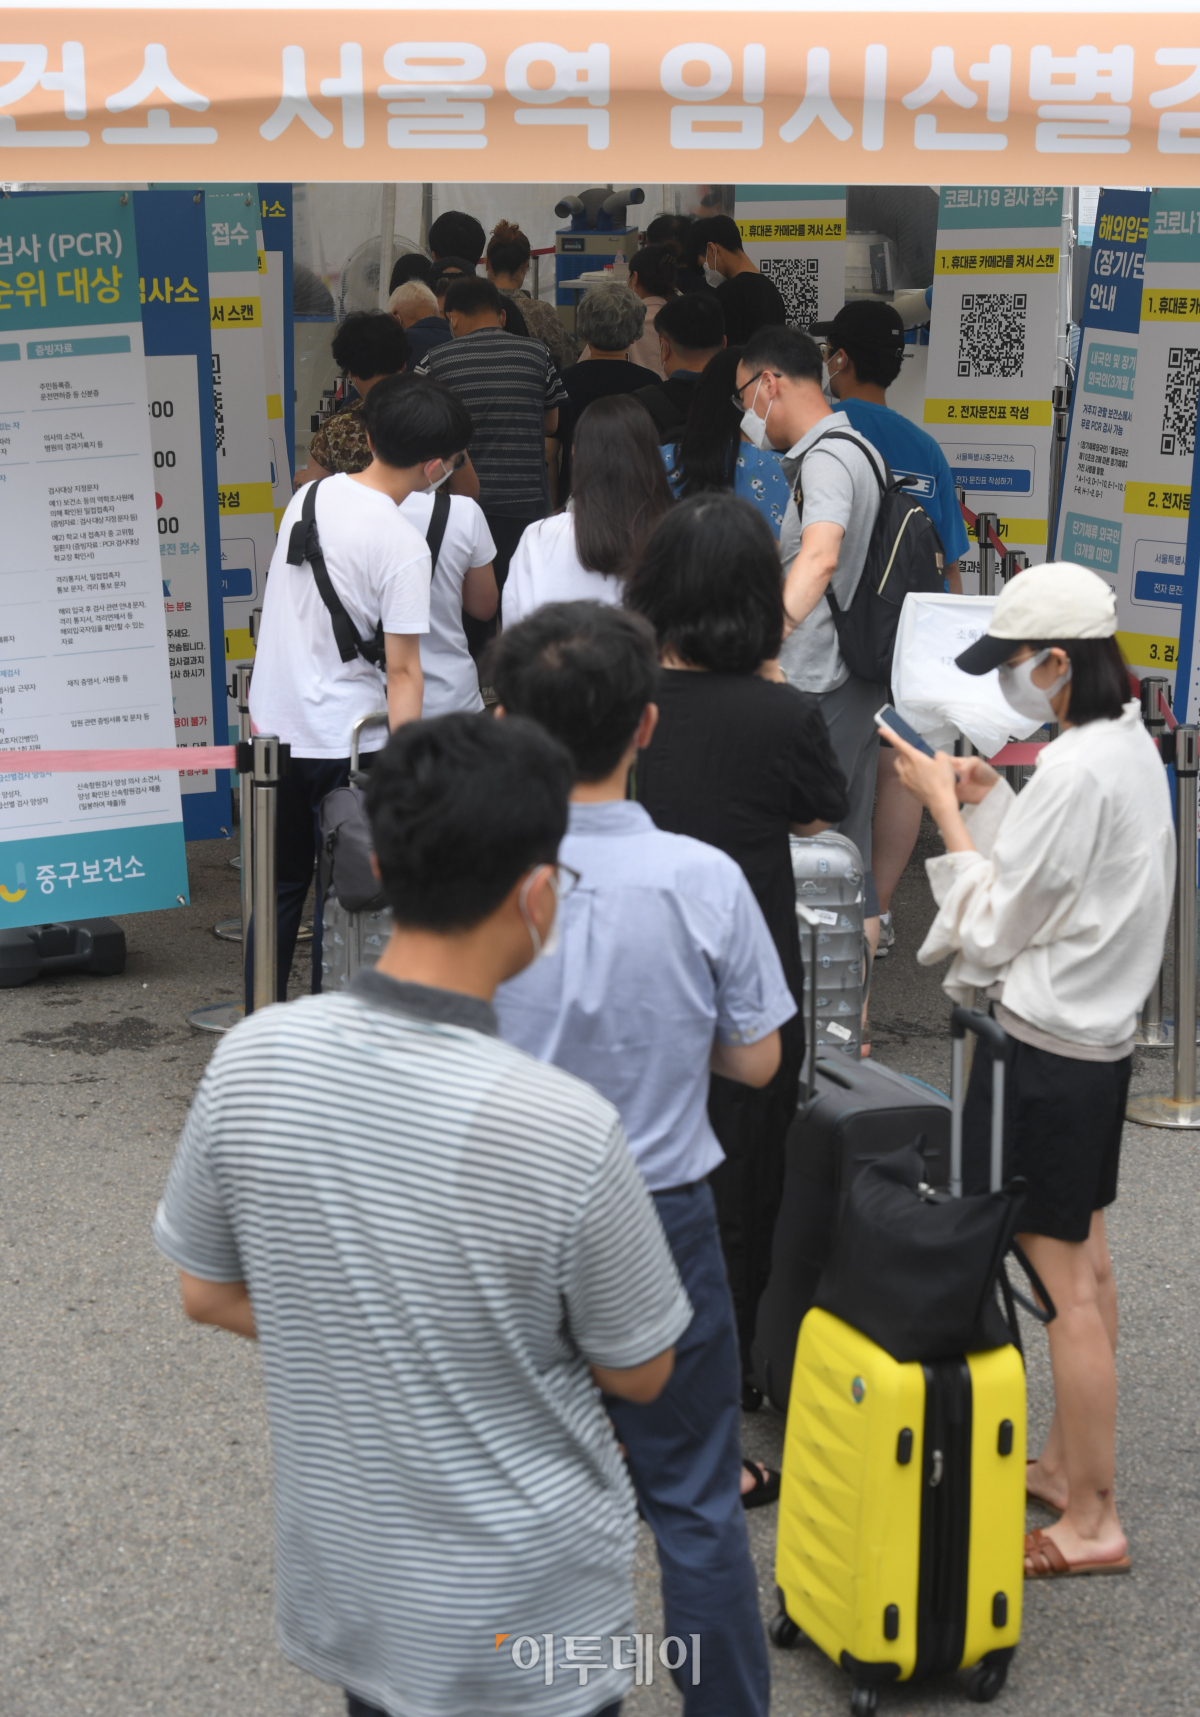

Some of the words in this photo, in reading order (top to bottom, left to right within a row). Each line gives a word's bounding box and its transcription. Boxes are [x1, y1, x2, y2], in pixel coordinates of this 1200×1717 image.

[0, 40, 218, 147] 건소
[259, 40, 611, 151] 서울역
[944, 189, 1001, 208] 코로나19
[1004, 188, 1029, 207] 검사
[1033, 187, 1059, 206] 접수
[211, 222, 249, 246] 접수
[740, 227, 747, 237] 1.
[749, 225, 772, 237] 휴대폰
[774, 224, 805, 237] 카메라를
[807, 224, 823, 236] 켜서
[825, 224, 841, 236] 스캔
[48, 229, 122, 263] (PCR)
[941, 257, 949, 269] 1.
[951, 255, 977, 269] 휴대폰
[979, 254, 1014, 269] 카메라를
[1016, 254, 1034, 268] 켜서
[1036, 254, 1054, 268] 스캔
[57, 265, 123, 304] 대상
[1089, 283, 1117, 312] 안내
[227, 304, 254, 321] 스캔
[1148, 297, 1157, 313] 1.
[1158, 296, 1188, 315] 휴대폰
[35, 343, 73, 357] 증빙자료
[1090, 350, 1112, 368] 내국인
[1113, 354, 1121, 369] 및
[40, 381, 73, 392] 주민등록증,
[40, 390, 71, 402] 운전면허증
[73, 389, 79, 399] 등
[81, 387, 99, 399] 신분증
[947, 405, 957, 419] 2.
[960, 405, 1007, 420] 전자문진표
[1009, 406, 1029, 420] 작성
[1083, 404, 1097, 416] 거주지
[1098, 406, 1108, 419] 관할
[1108, 408, 1133, 423] 보건소에서
[1080, 418, 1090, 431] 무료
[1091, 421, 1101, 432] PCR
[1102, 422, 1112, 435] 검사
[1113, 424, 1124, 436] 가능
[44, 434, 63, 443] 의사의
[64, 432, 85, 443] 소견서,
[45, 443, 63, 453] 병원의
[65, 440, 96, 452] 경과기록지
[98, 440, 103, 450] 등
[153, 451, 176, 469] 00
[955, 452, 1015, 463] 서울특별시중구보건소
[955, 476, 968, 484] 전자
[969, 476, 987, 485] 문진표
[988, 476, 1013, 486] 작성하기
[48, 486, 73, 496] 검사대상
[74, 483, 99, 494] 지정문자
[64, 497, 82, 506] 보건소
[84, 496, 96, 505] 등의
[1148, 491, 1158, 508] 2.
[51, 508, 63, 517] 의해
[65, 506, 83, 517] 확인된
[84, 505, 115, 516] 밀접접촉자
[51, 517, 76, 528] (증빙자료
[157, 516, 180, 534] 00
[66, 532, 78, 541] 학교
[80, 531, 87, 540] 내
[88, 530, 106, 540] 접촉자
[108, 529, 114, 538] 중
[115, 528, 134, 538] 고위험
[1072, 520, 1098, 540] 단기체류
[1099, 525, 1120, 546] 외국인
[53, 543, 71, 553] 질환자
[72, 541, 98, 551] (증빙자료
[102, 540, 116, 548] PCR
[116, 538, 139, 548] 검사대상
[179, 542, 200, 555] 접수
[54, 553, 72, 563] 학교장
[74, 551, 94, 562] 확인서)
[1074, 541, 1095, 561] (3개월
[1095, 548, 1113, 566] 미만)
[56, 574, 88, 585] 격리통지서,
[89, 571, 120, 582] 밀접접촉자
[57, 586, 69, 595] 통보
[70, 584, 85, 594] 문자,
[86, 583, 98, 592] 격리
[100, 581, 113, 592] 통보
[114, 581, 126, 590] 문자
[1153, 583, 1167, 595] 전자
[58, 606, 71, 615] 해외
[72, 605, 84, 614] 입국
[85, 604, 92, 613] 후
[93, 604, 105, 613] 검사
[106, 603, 118, 612] 관련
[119, 601, 131, 610] 안내
[132, 601, 146, 610] 문자,
[176, 601, 192, 612] 분은
[60, 616, 72, 625] 격리
[73, 615, 93, 624] 통지서,
[95, 612, 126, 623] 격리면제서
[127, 611, 133, 620] 등
[60, 625, 103, 635] 해외입국자임을
[104, 622, 123, 632] 확인할
[124, 622, 131, 630] 수
[132, 621, 145, 630] 있는
[167, 629, 190, 639] 주세요.
[61, 638, 74, 646] 자료
[168, 642, 206, 652] 전송됩니다.
[1149, 644, 1160, 662] 3.
[1164, 645, 1179, 664] 검
[168, 656, 205, 667] 검사결과지
[183, 668, 205, 679] 하시기
[18, 684, 36, 692] 근무자
[67, 678, 79, 688] 재직
[81, 677, 102, 687] 증명서,
[102, 675, 121, 685] 사원증
[122, 674, 128, 683] 등
[70, 719, 83, 728] 입원
[84, 718, 96, 727] 관련
[97, 715, 121, 726] 증빙서류
[122, 714, 129, 724] 및
[129, 714, 142, 723] 문자
[143, 713, 150, 721] 등
[191, 716, 208, 727] 불가
[77, 780, 113, 792] 신속항원검사
[114, 778, 127, 788] 양성
[127, 777, 140, 787] 의사
[141, 775, 162, 785] 소견서,
[2, 790, 22, 799] 양성자,
[78, 792, 91, 802] 양성
[91, 789, 110, 800] 확인된
[111, 787, 147, 798] 신속항원검사
[148, 784, 161, 794] 제품
[17, 799, 29, 808] 검사
[30, 797, 49, 806] 양성자
[78, 800, 105, 811] (밀봉하여
[36, 855, 146, 894] 중구보건소
